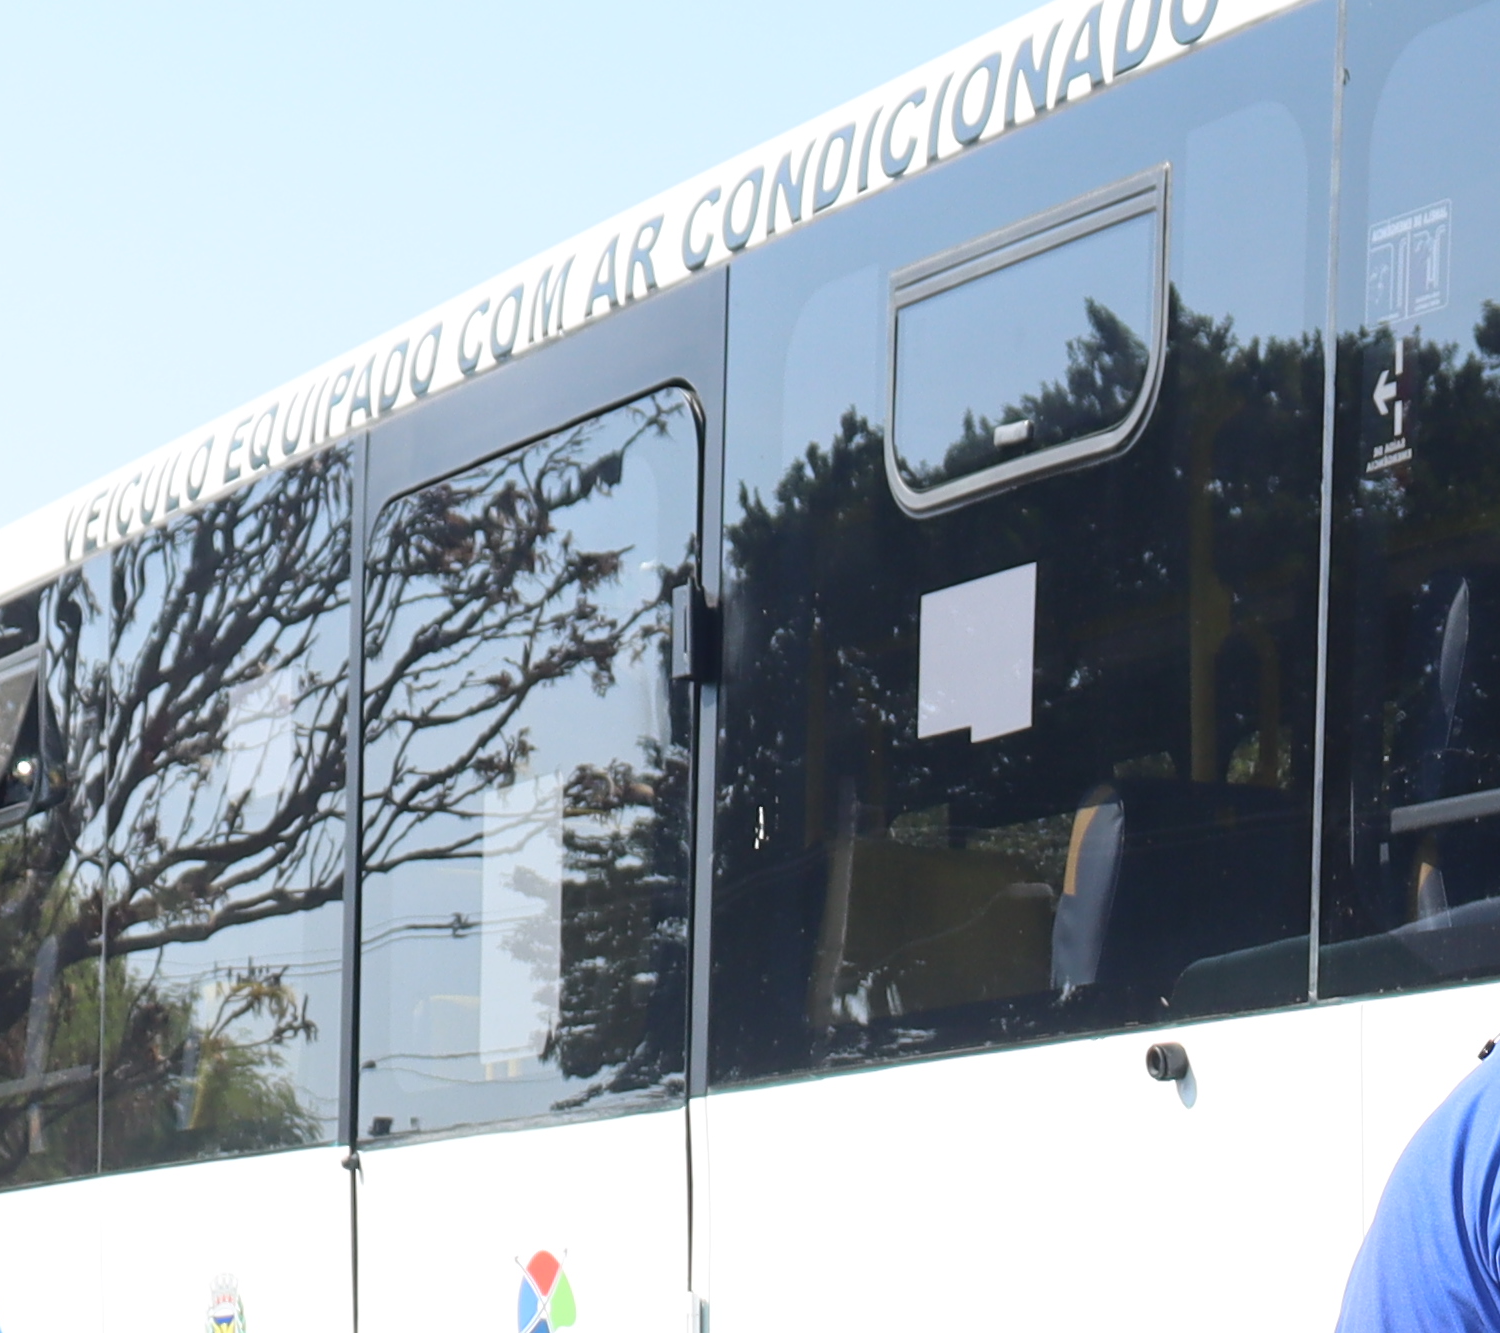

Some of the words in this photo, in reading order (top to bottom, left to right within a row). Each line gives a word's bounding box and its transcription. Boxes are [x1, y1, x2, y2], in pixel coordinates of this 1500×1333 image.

[65, 433, 215, 565] VEICULO
[222, 320, 443, 485] EQUIPADO
[457, 253, 576, 376] COM
[584, 212, 664, 317] AR
